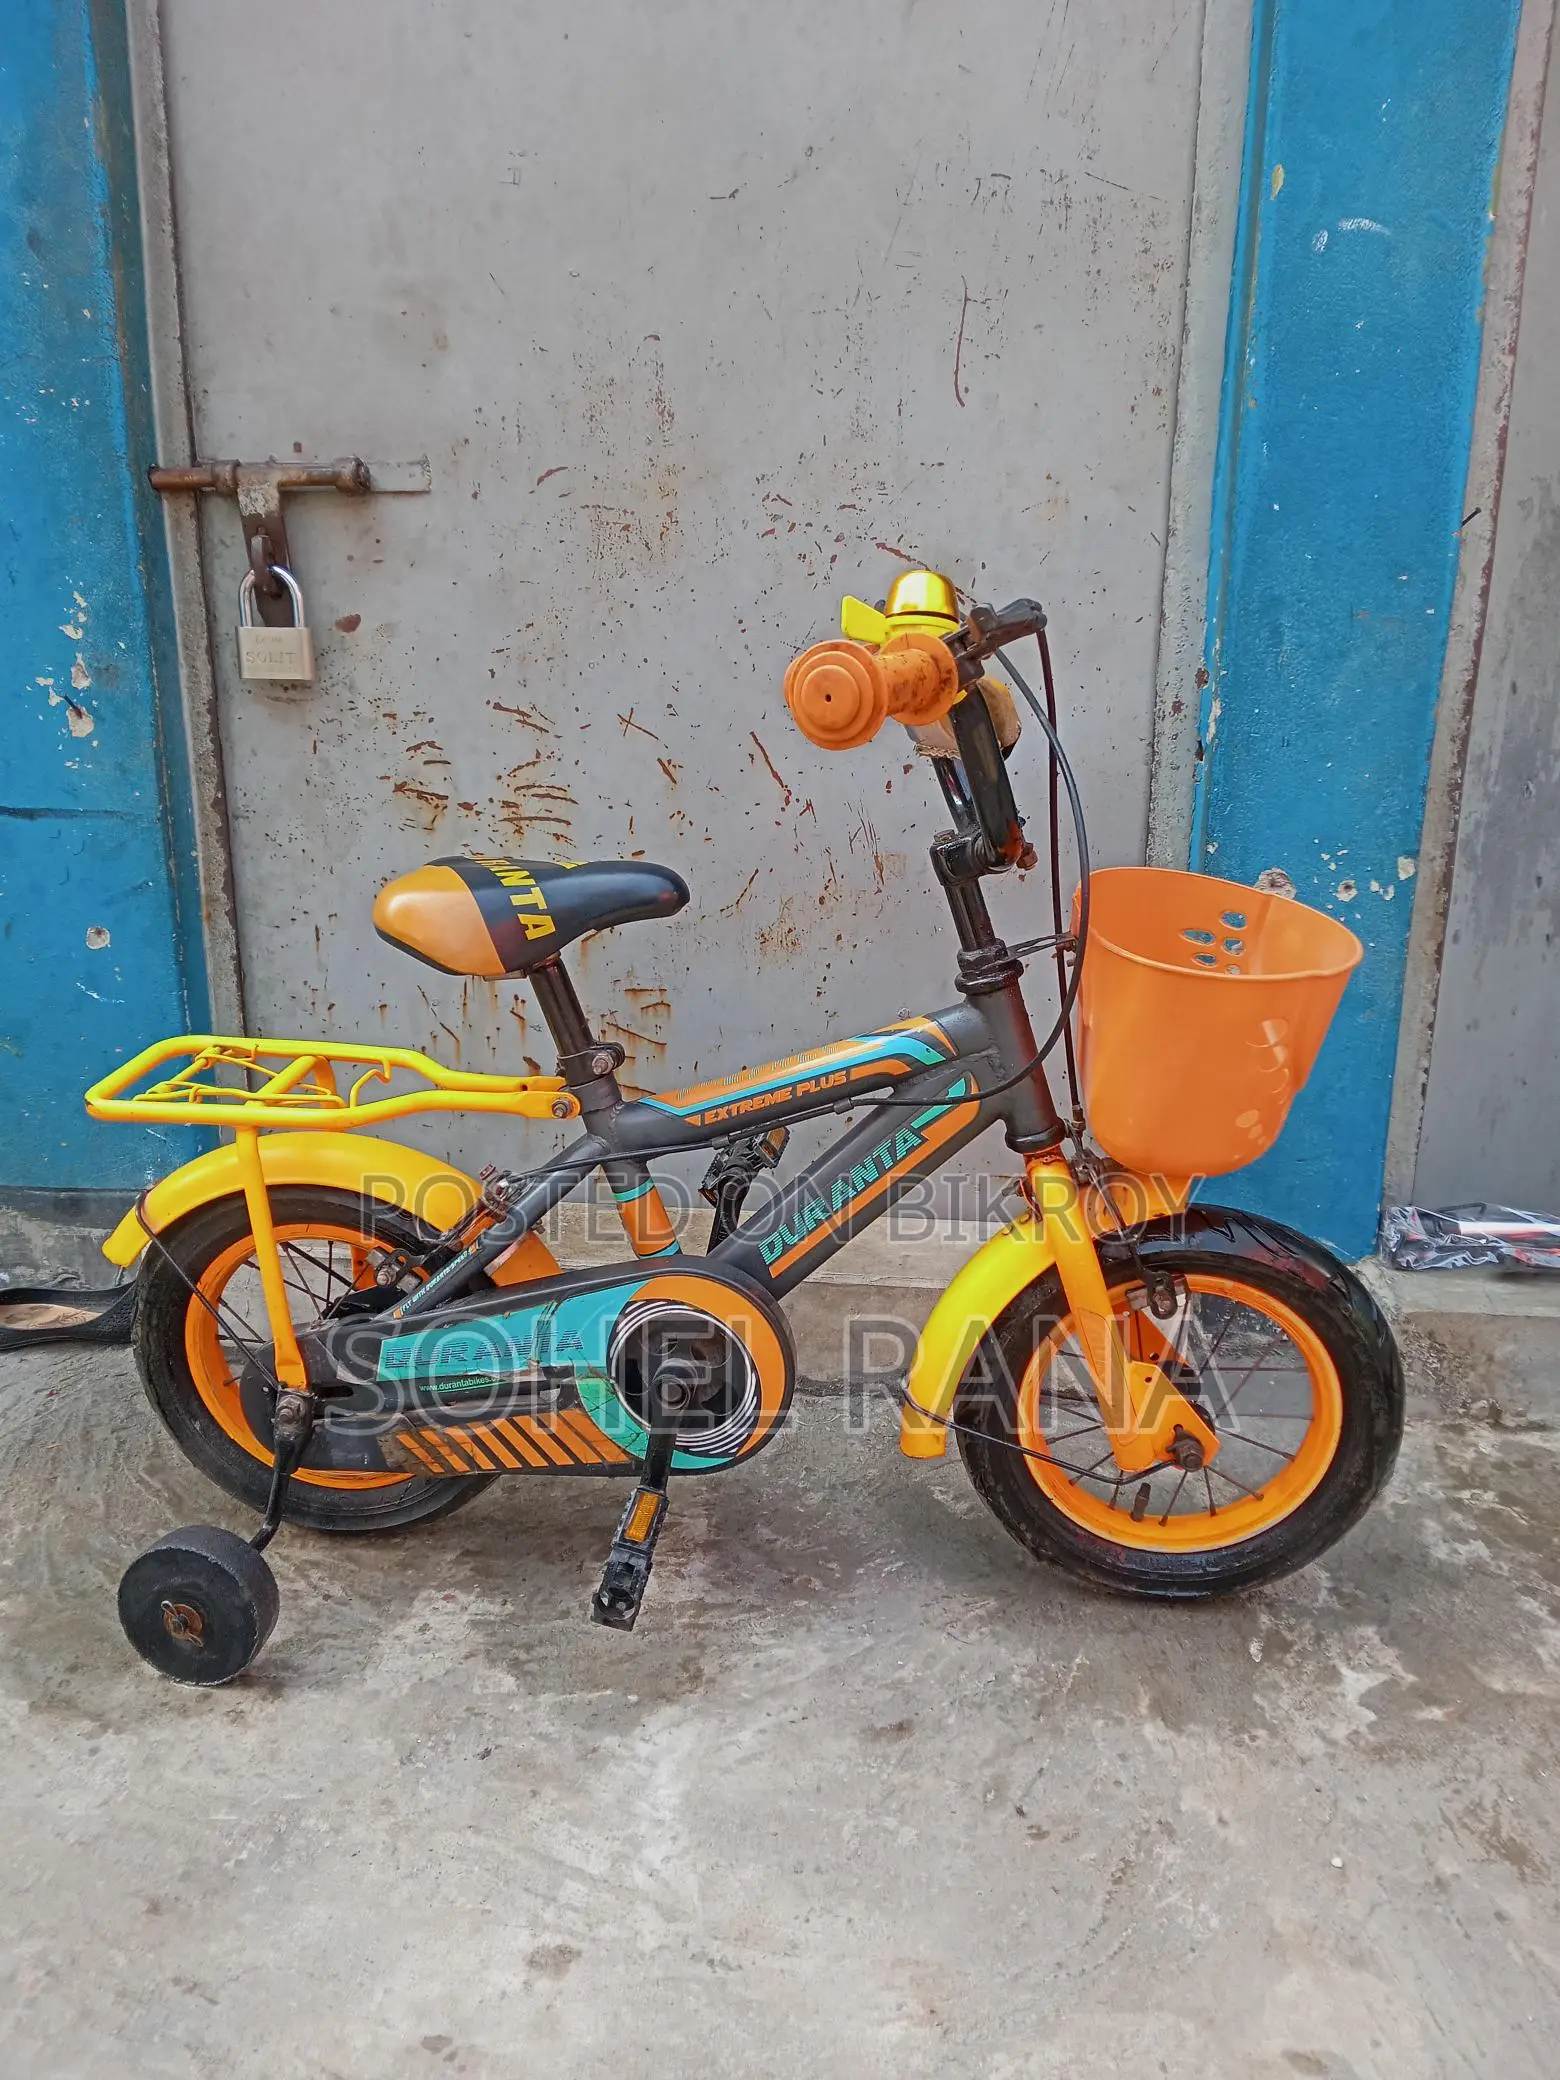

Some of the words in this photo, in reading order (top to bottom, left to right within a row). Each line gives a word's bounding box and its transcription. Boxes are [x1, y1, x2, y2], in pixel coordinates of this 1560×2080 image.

[704, 1087, 793, 1125] EXTREME
[796, 1070, 847, 1096] PLUS
[758, 1127, 922, 1265] DURANTA
